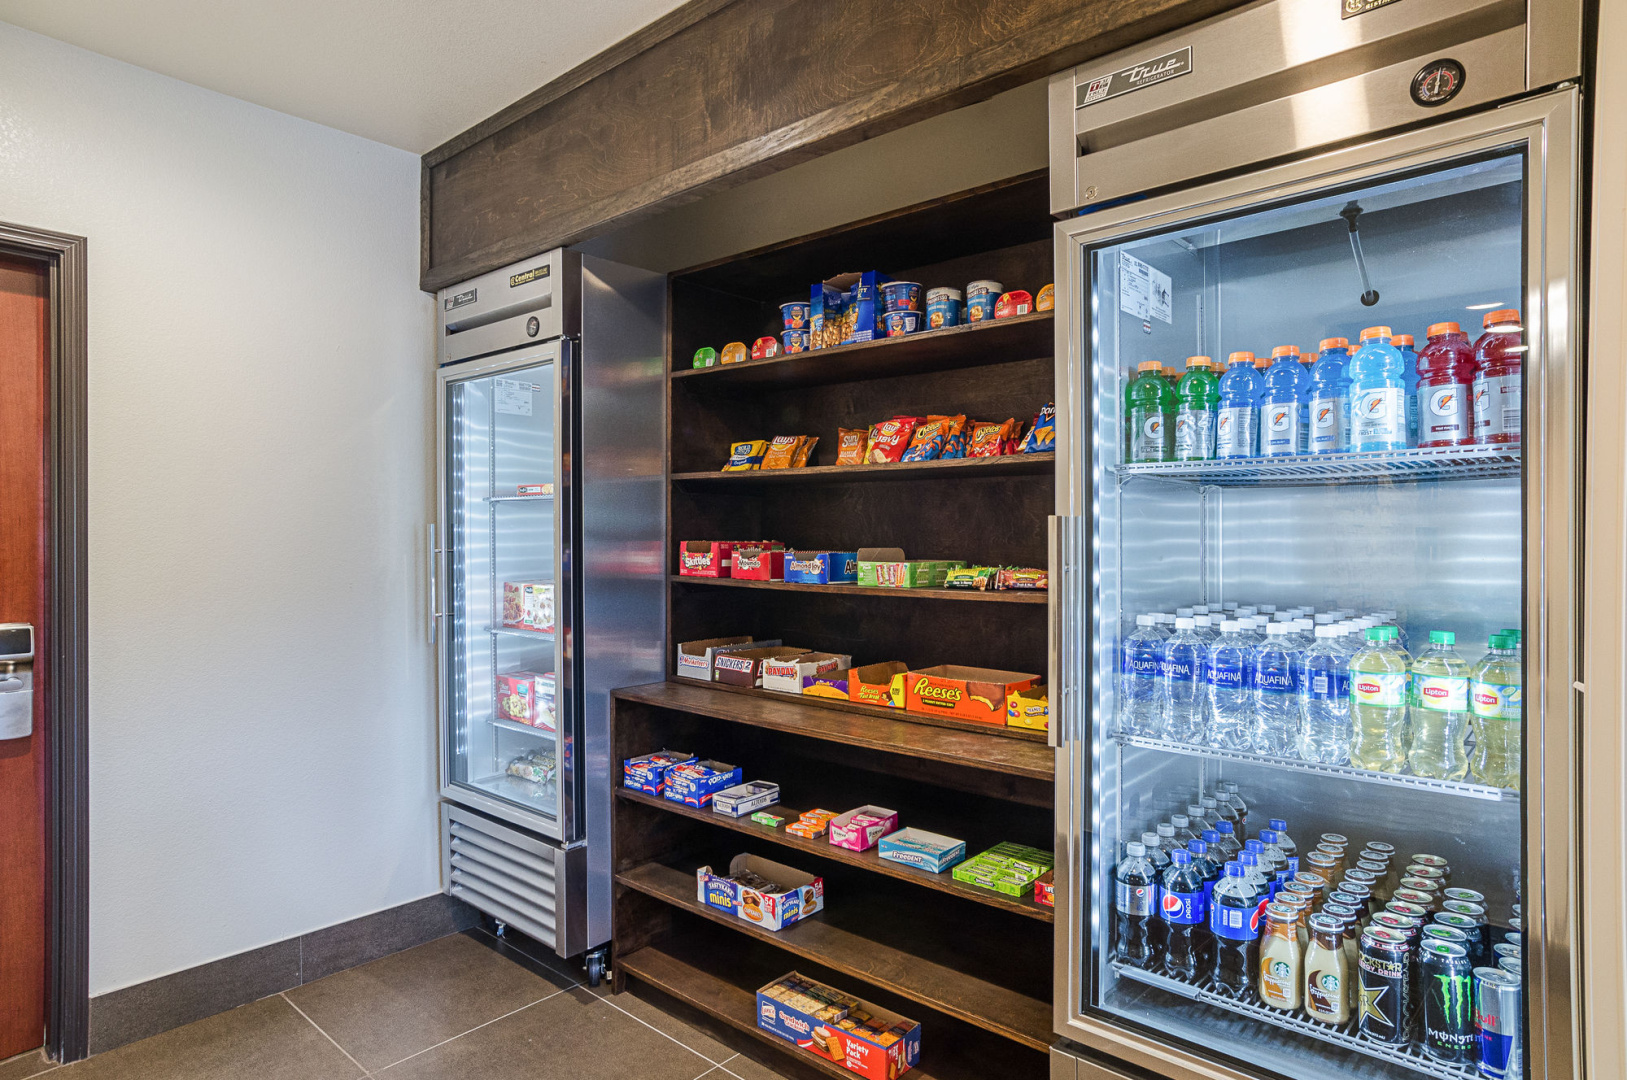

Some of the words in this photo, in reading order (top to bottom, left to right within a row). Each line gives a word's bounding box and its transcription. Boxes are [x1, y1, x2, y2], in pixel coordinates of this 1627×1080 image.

[1136, 69, 1175, 86] REFRIGERATOR
[514, 269, 535, 283] Central
[1360, 391, 1386, 419] G
[1430, 388, 1458, 417] G
[1268, 406, 1290, 432] G
[1312, 401, 1334, 428] G
[1144, 416, 1164, 439] G
[685, 555, 711, 567] Skittles
[738, 558, 761, 568] Mounds
[790, 560, 811, 571] Almond
[716, 656, 744, 670] SNICKERS
[744, 661, 752, 669] 2
[1128, 659, 1161, 671] AQUAFIN
[768, 667, 794, 676] PAYDAY
[1207, 668, 1243, 683] AQUAFINA
[1254, 670, 1294, 687] AQUAFINA
[860, 685, 879, 694] Reese's
[913, 677, 963, 702] Reese's
[1358, 684, 1379, 692] Lipton
[1425, 688, 1447, 697] Lipton
[1475, 695, 1496, 704] Lipton
[708, 881, 735, 898] TASTYKAKE
[814, 882, 823, 891] 54
[710, 891, 732, 908] minis
[764, 897, 773, 906] 54
[783, 906, 799, 920] minis
[1358, 951, 1403, 973] OCKSTAR
[1377, 968, 1403, 978] DRINK
[778, 1010, 810, 1031] Sandwich
[845, 1038, 869, 1056] Variety
[846, 1046, 861, 1060] Pack
